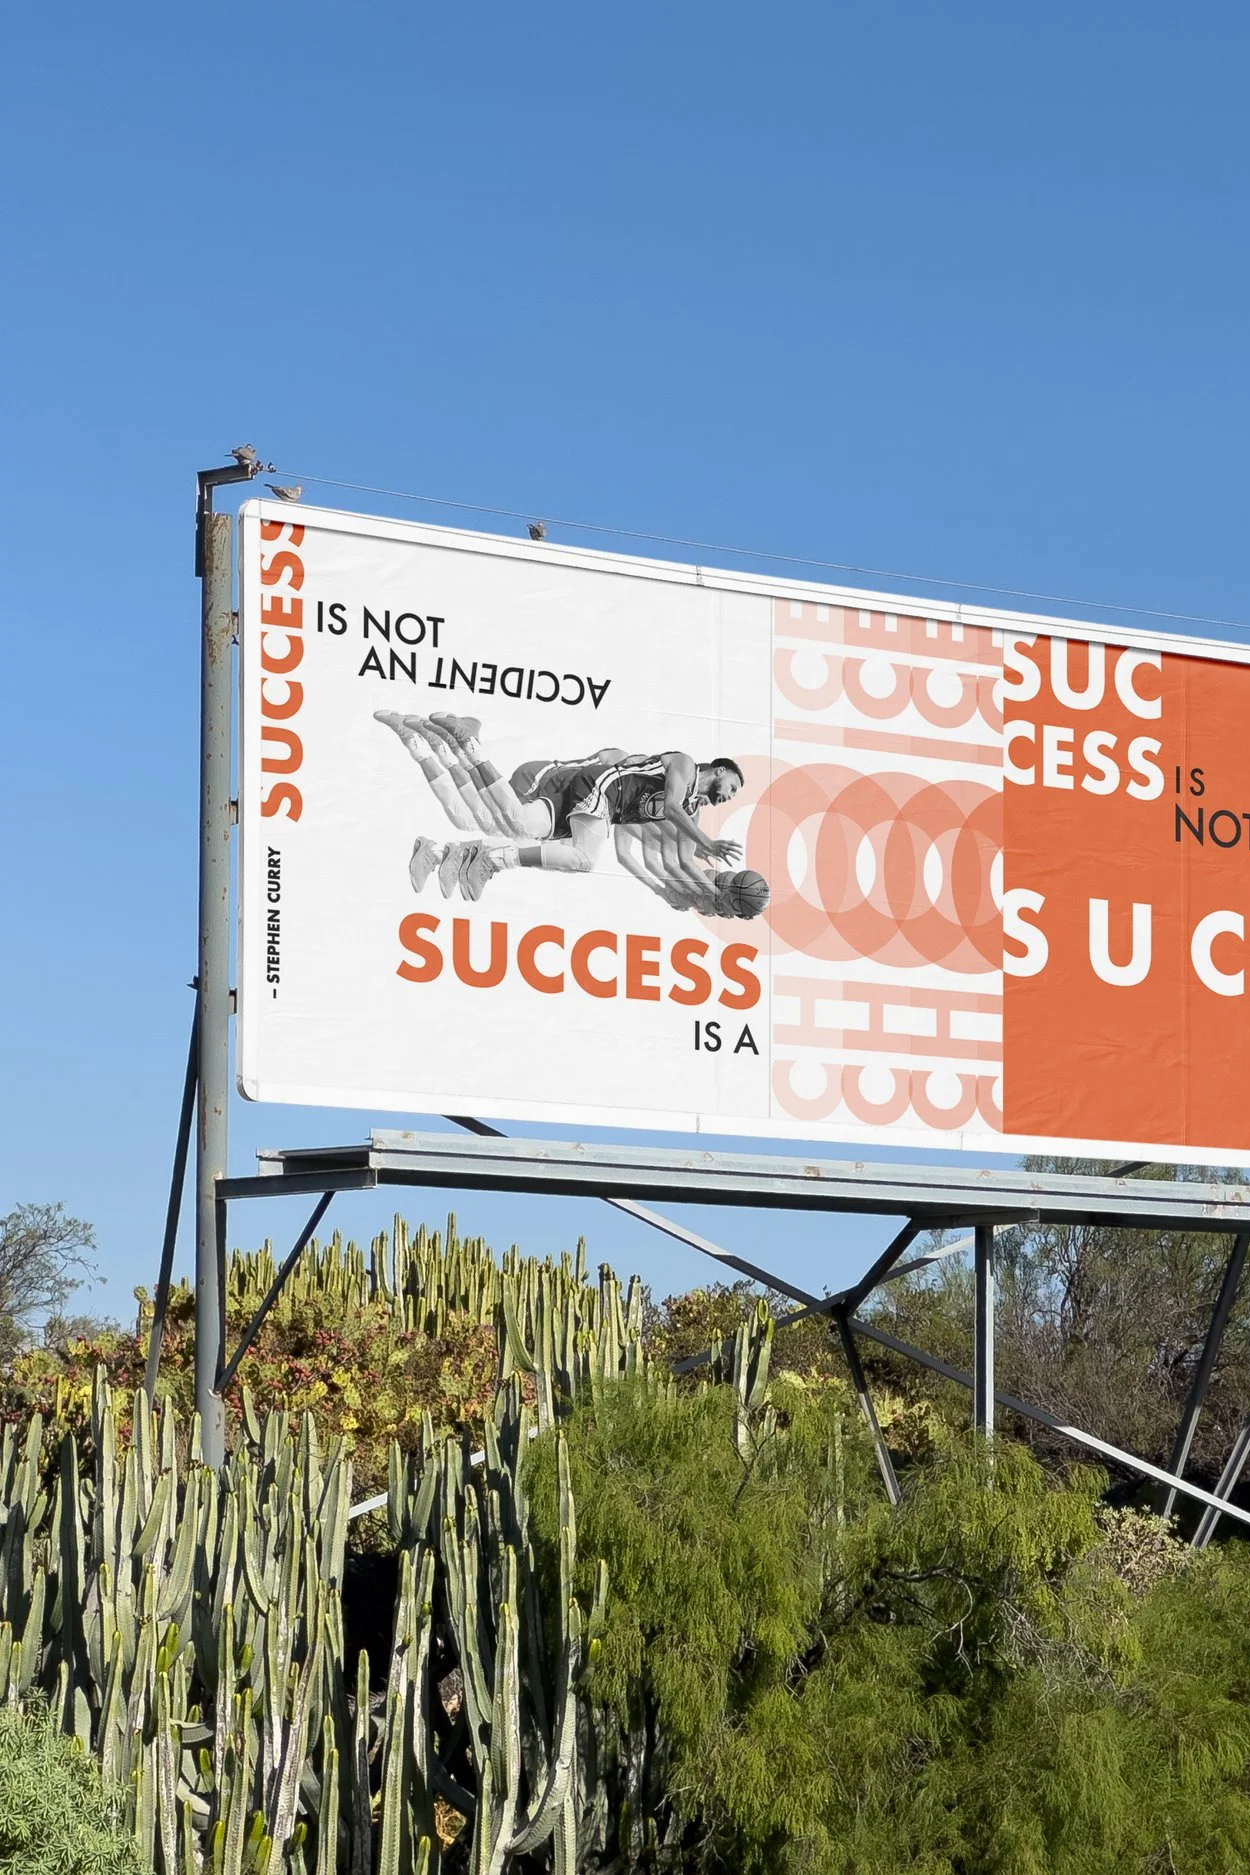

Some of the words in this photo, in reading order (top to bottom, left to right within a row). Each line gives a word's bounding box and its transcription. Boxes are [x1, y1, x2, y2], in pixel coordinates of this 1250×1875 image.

[316, 600, 348, 636] IS
[364, 606, 445, 648] NOT
[260, 519, 305, 823] SUCCESS
[358, 645, 417, 685] AN
[428, 656, 612, 710] ACCIDENT
[1003, 633, 1162, 720] SUC
[1003, 720, 1165, 801] CESS
[1175, 766, 1205, 797] IS
[267, 846, 281, 904] CURRY
[266, 908, 281, 984] STEPHEN
[396, 912, 762, 1011] SUCCESS
[694, 1020, 722, 1052] IS
[733, 1023, 760, 1056] A
